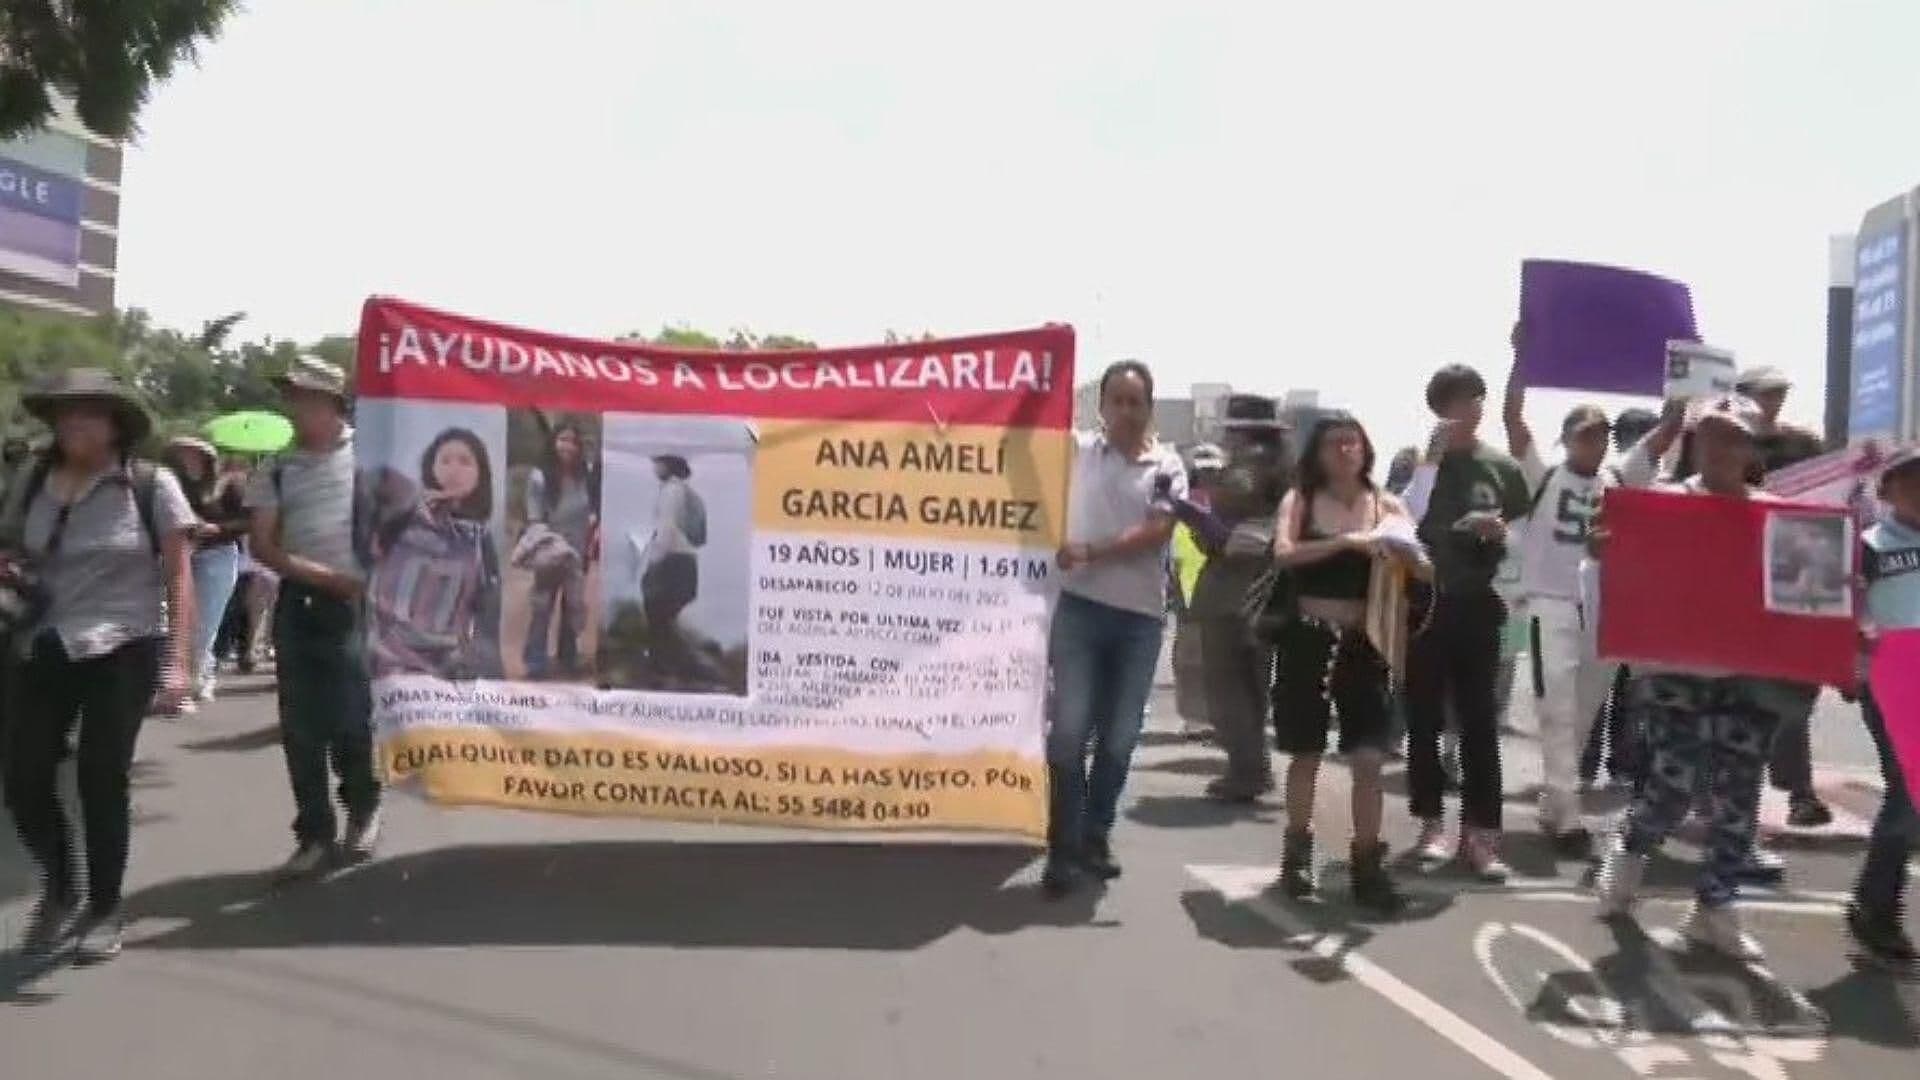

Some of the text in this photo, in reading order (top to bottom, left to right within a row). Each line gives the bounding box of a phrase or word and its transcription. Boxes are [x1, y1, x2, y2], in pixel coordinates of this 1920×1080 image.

[673, 364, 705, 391] A
[717, 350, 1052, 392] LOCALIZARLA!
[816, 439, 889, 472] ANA
[782, 489, 1039, 530] GARCIA GAMEZ
[768, 545, 791, 564] 19
[797, 541, 860, 566] AÑOS
[884, 550, 954, 576] MUJER
[980, 557, 1019, 578] 1.61
[1028, 559, 1048, 580] M
[792, 608, 833, 622] VISTA
[840, 610, 870, 625] POR
[796, 652, 857, 668] VESTIDA
[392, 743, 538, 774] CUALQUIER
[544, 748, 615, 769] DATO
[622, 750, 649, 770] ES
[777, 762, 797, 782] SI
[804, 764, 834, 786] LA
[842, 767, 893, 787] HAS
[985, 767, 1033, 792] POR
[503, 776, 585, 801] FAVOR
[594, 781, 725, 809] CONTACTA
[734, 790, 769, 813] AL:
[777, 794, 804, 815] 55
[812, 796, 866, 819] 5484
